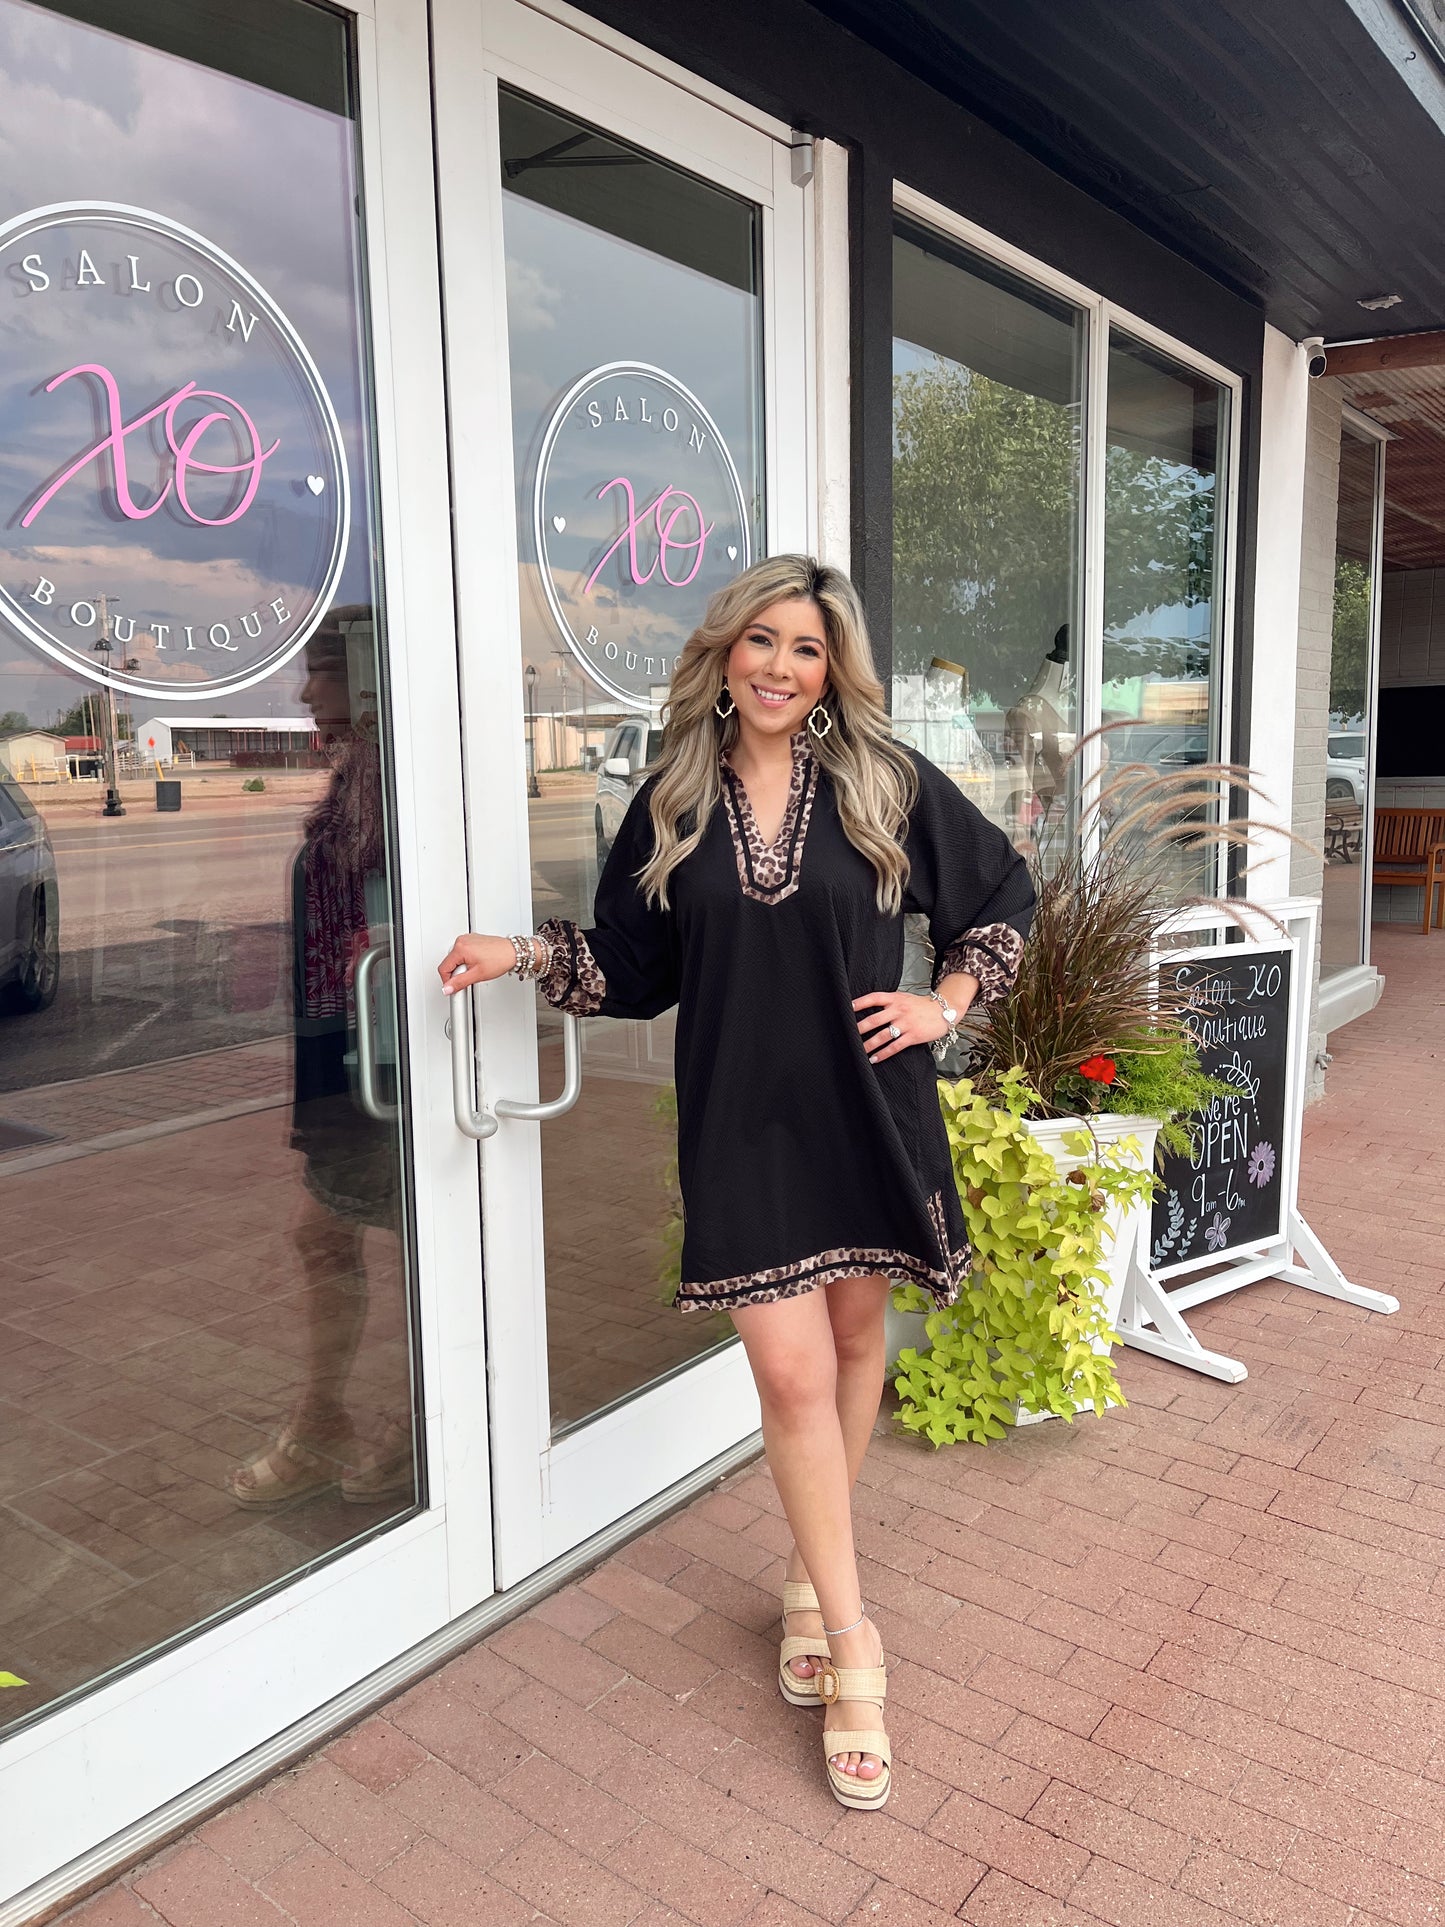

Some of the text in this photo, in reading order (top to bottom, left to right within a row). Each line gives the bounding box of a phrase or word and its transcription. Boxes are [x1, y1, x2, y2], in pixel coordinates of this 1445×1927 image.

[22, 249, 259, 342] SALON
[22, 363, 281, 527] XO
[587, 395, 706, 454] SALON
[584, 477, 716, 594] XO
[29, 576, 292, 653] BOUTIQUE
[585, 624, 683, 676] BOUTI
[1246, 963, 1282, 1000] XO
[1183, 1014, 1267, 1052] Boutique
[1190, 1112, 1249, 1170] OPEN
